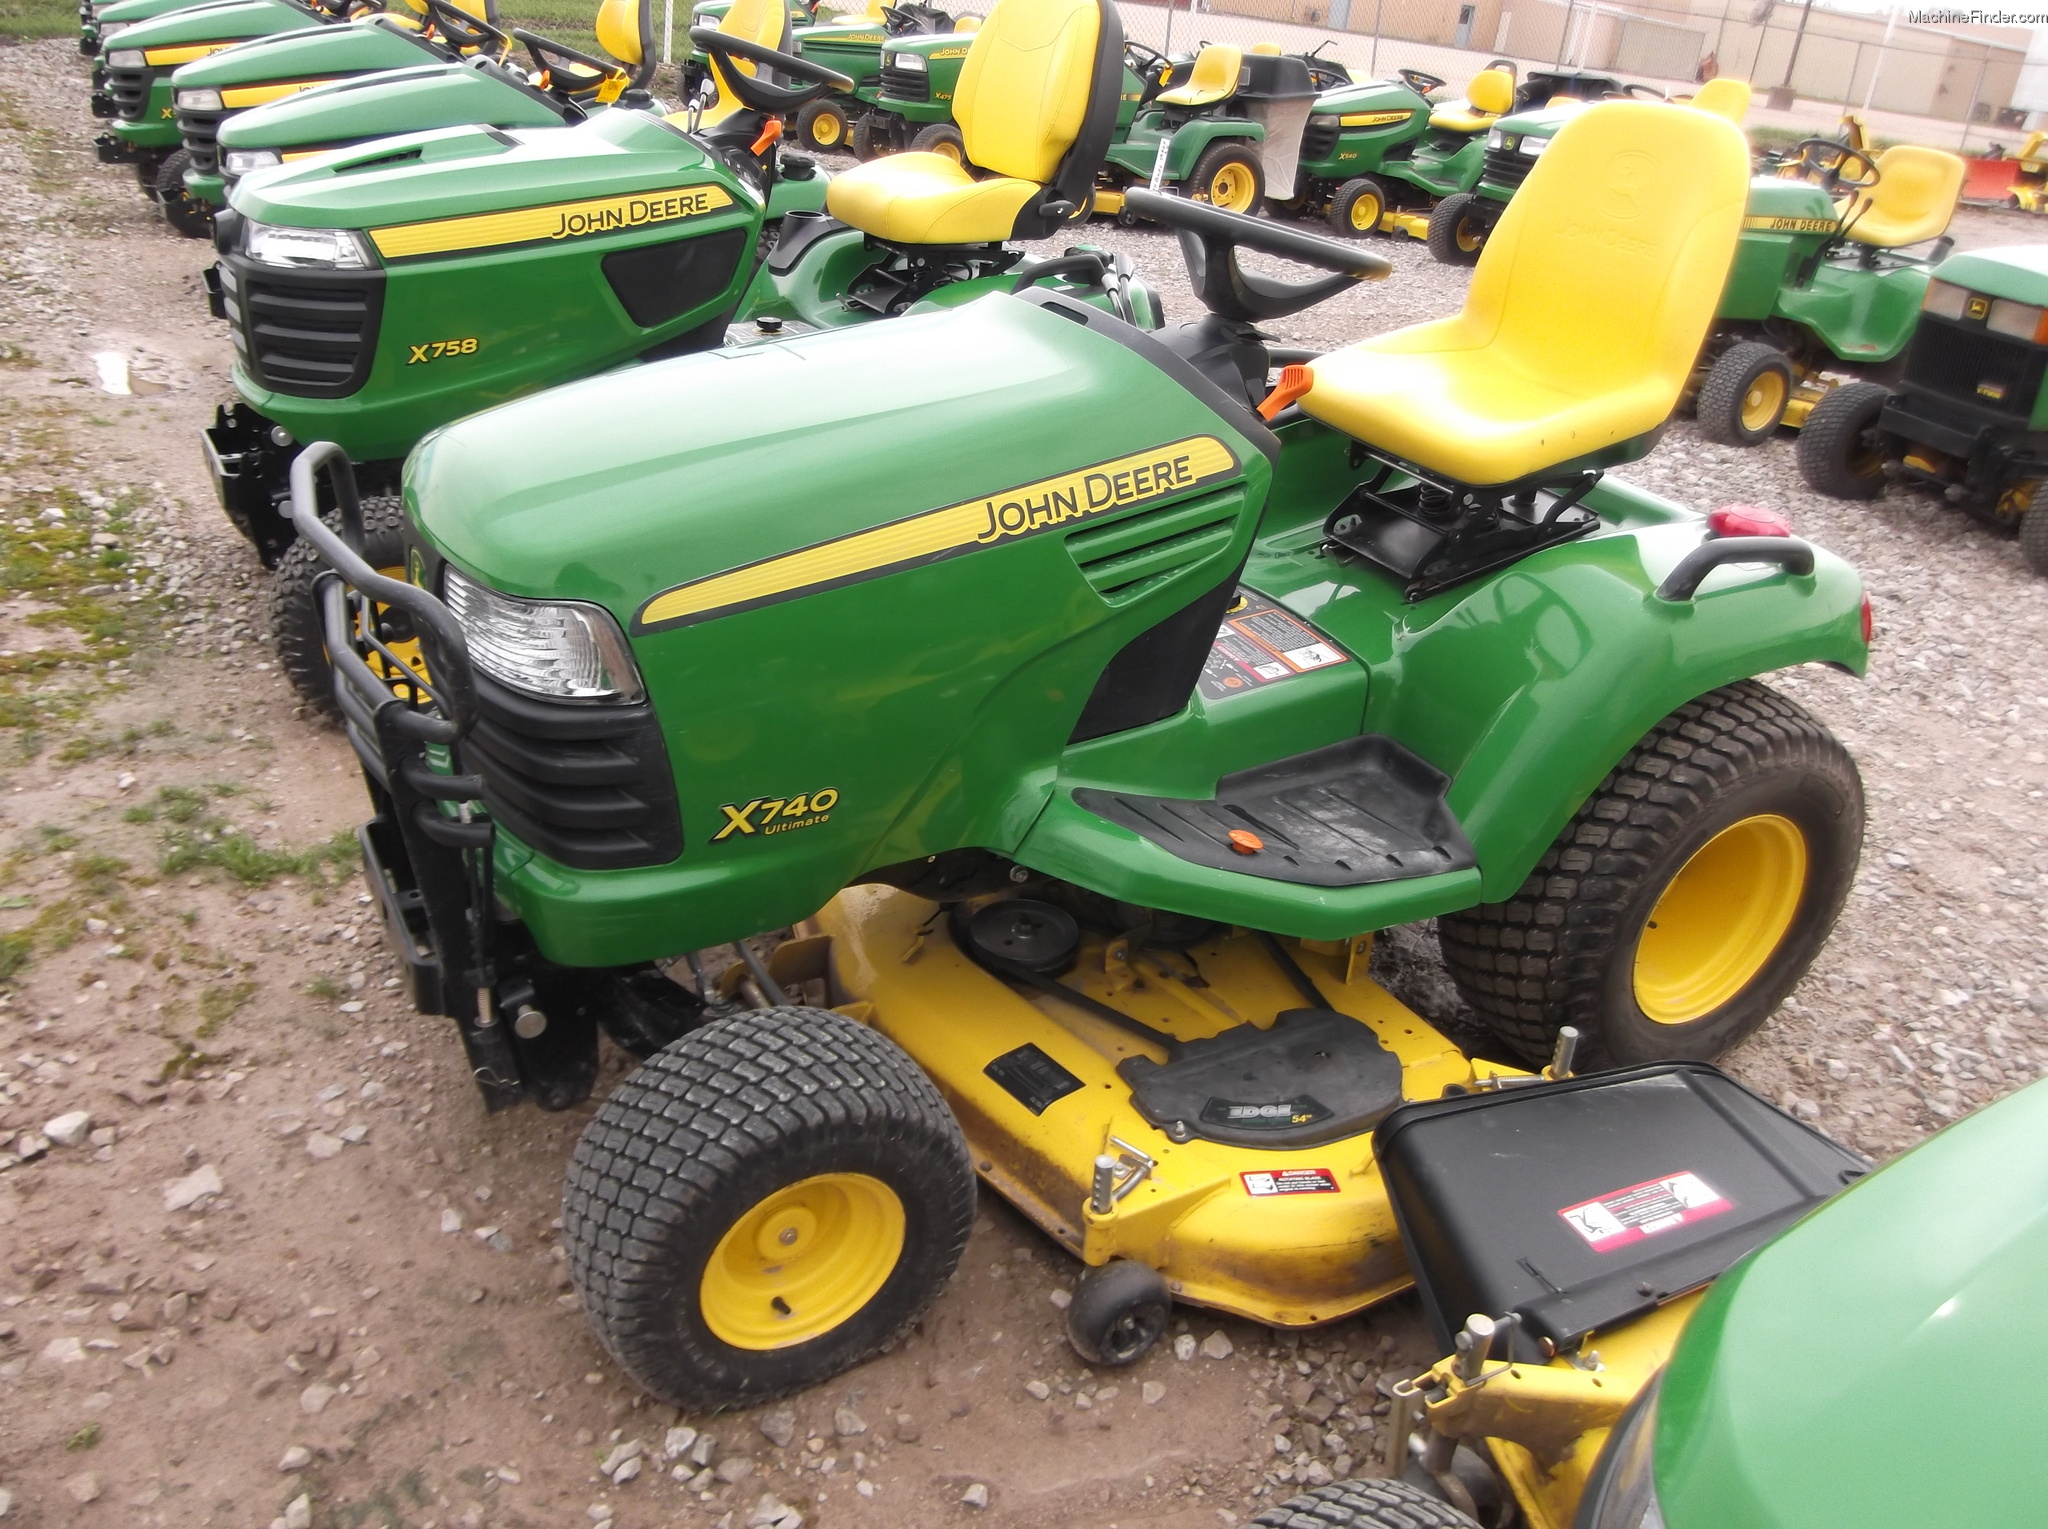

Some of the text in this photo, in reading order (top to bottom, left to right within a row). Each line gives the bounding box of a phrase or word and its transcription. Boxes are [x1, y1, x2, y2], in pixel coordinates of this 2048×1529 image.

[552, 193, 708, 237] JOHN DEERE
[1770, 219, 1833, 232] JOHN DEERE
[407, 338, 478, 364] X758
[977, 455, 1193, 540] JOHN DEERE
[711, 788, 839, 841] X740
[764, 814, 830, 835] Ultimate
[1227, 1104, 1293, 1119] EDGE
[1291, 1114, 1312, 1123] 54"
